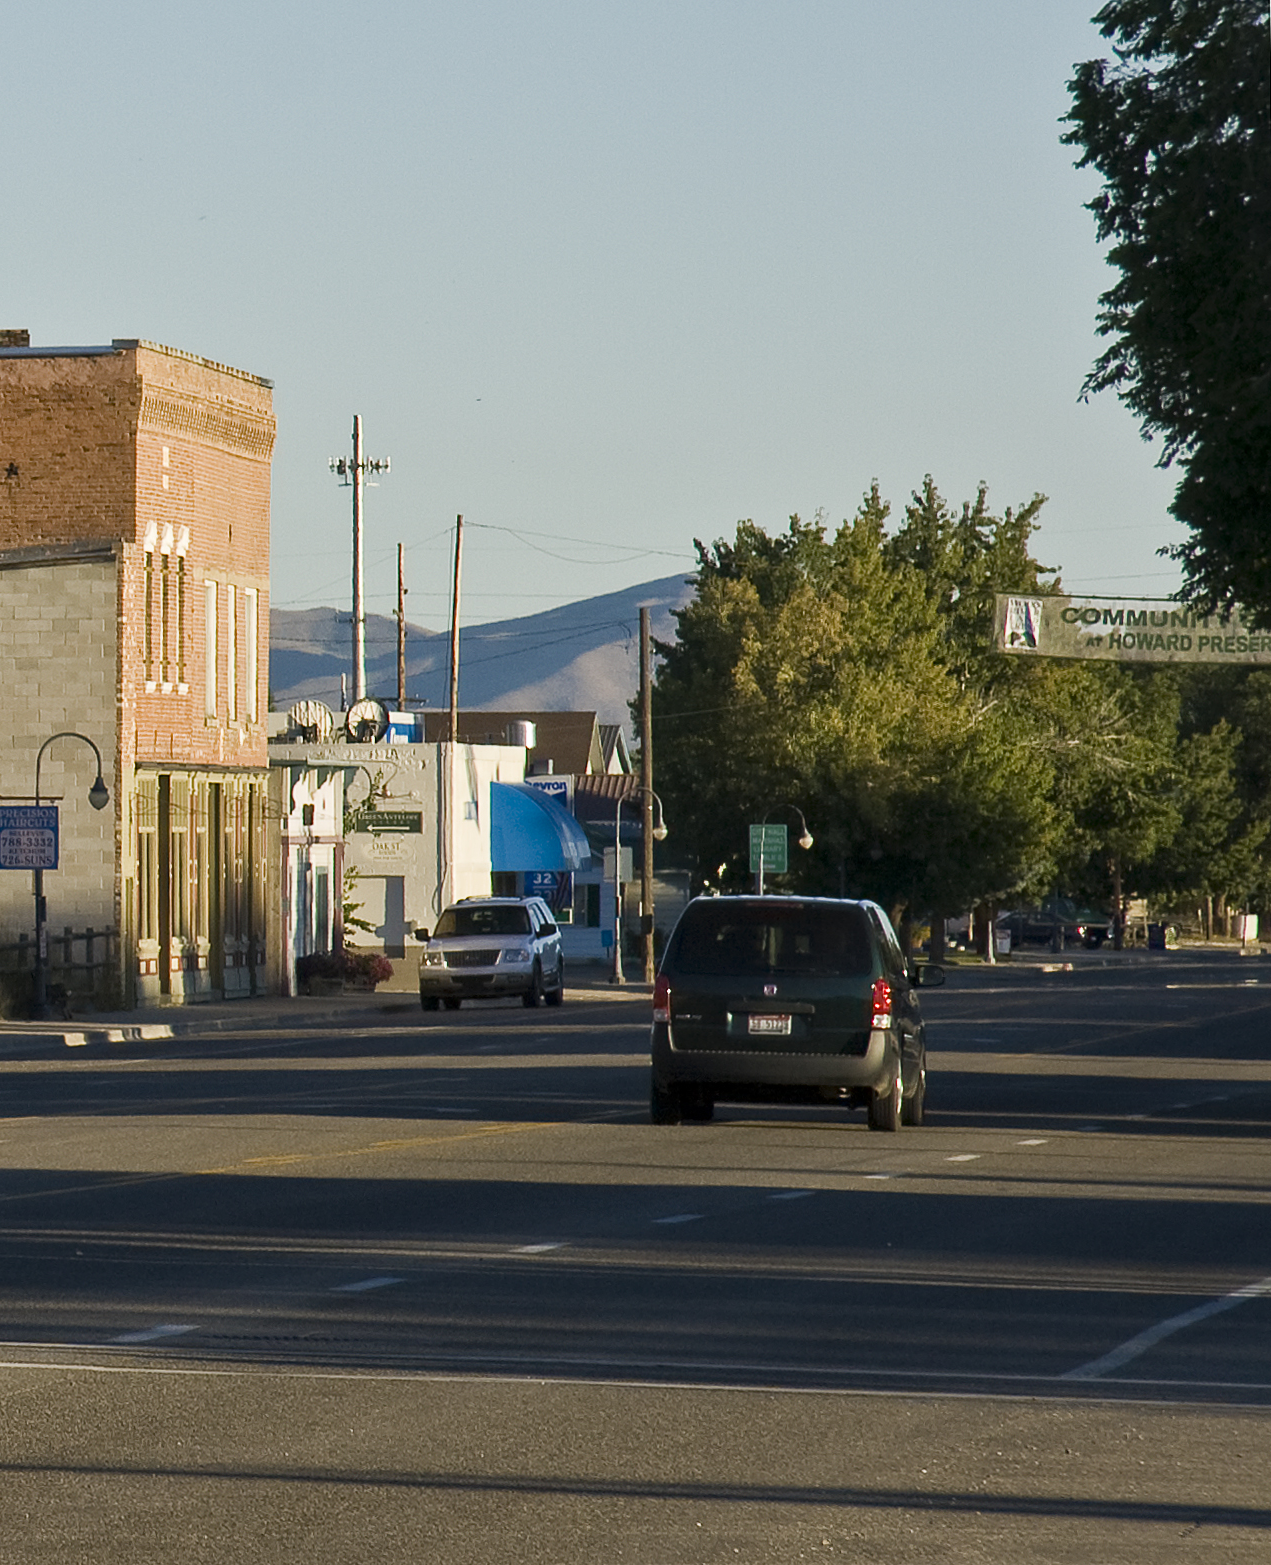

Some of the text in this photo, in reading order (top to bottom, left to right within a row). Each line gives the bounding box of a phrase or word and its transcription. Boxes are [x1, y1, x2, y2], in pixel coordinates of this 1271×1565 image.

[1109, 632, 1193, 652] HOWARD
[0, 809, 56, 818] PRECISION
[0, 819, 56, 828] HAIRCUTS
[2, 837, 53, 848] 788-3332
[2, 856, 53, 866] 726-SUNS
